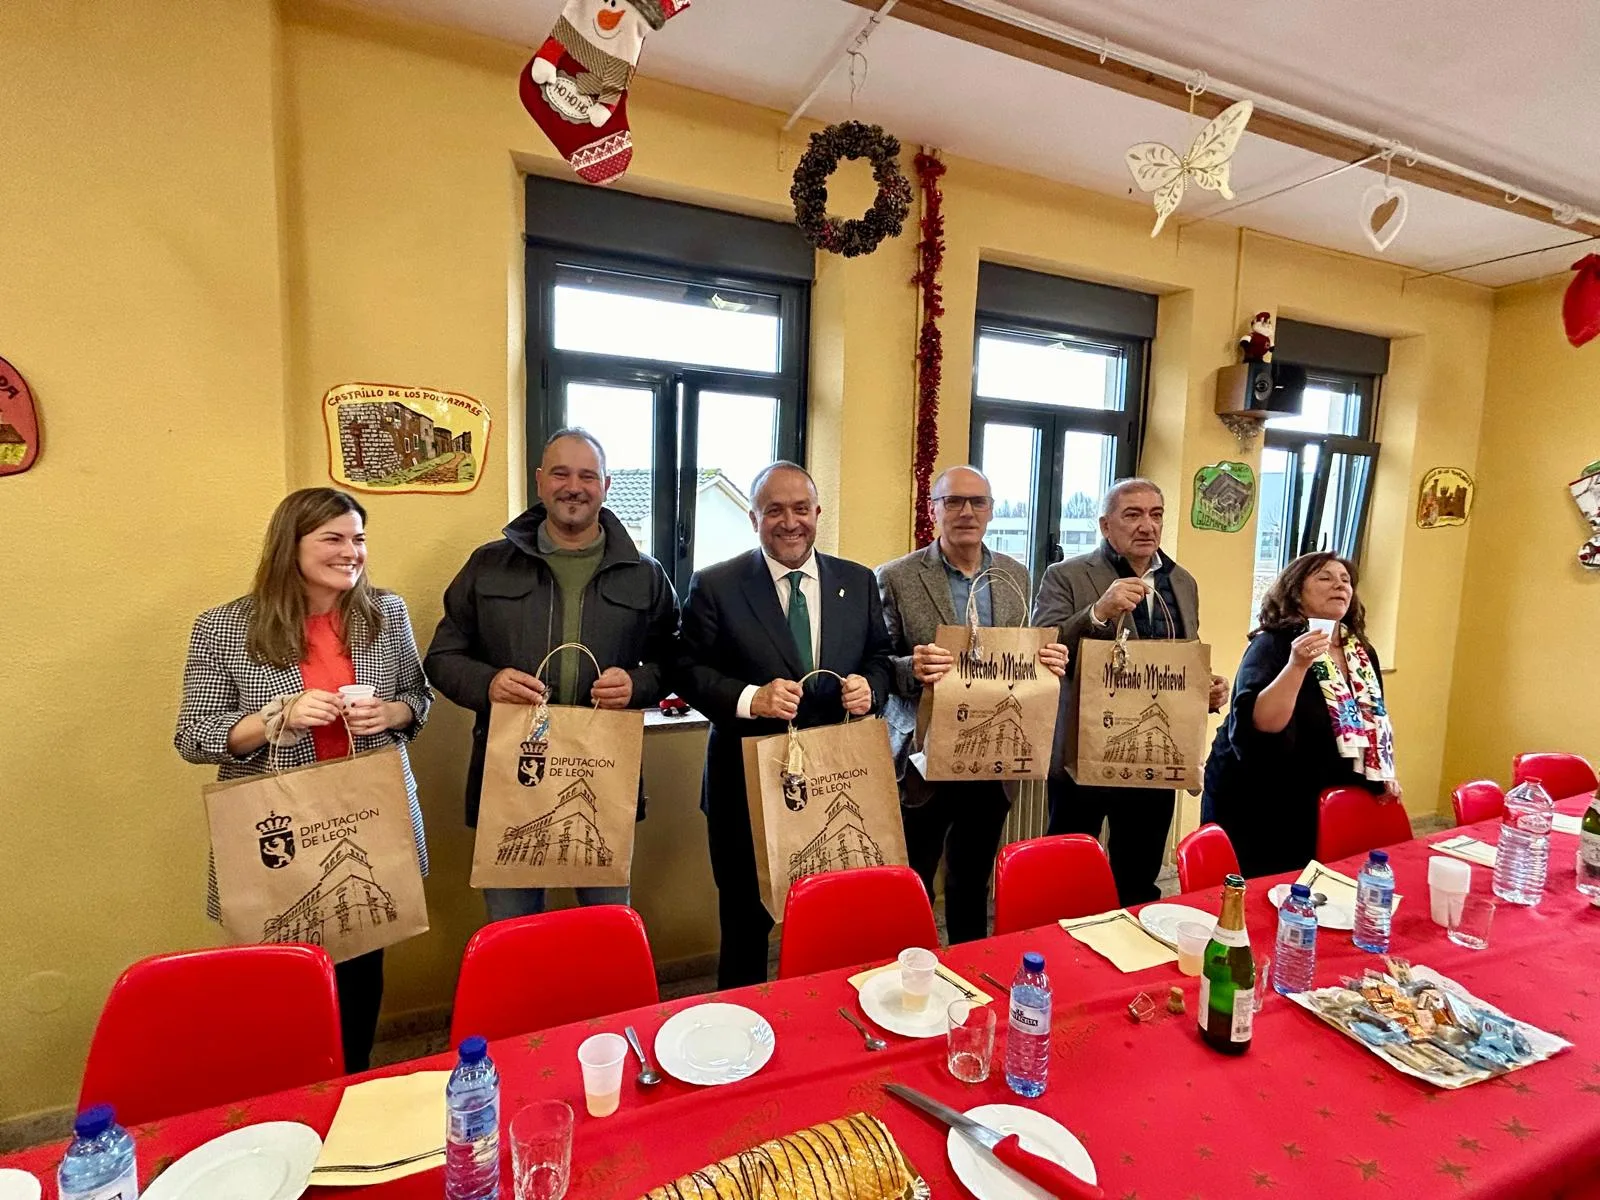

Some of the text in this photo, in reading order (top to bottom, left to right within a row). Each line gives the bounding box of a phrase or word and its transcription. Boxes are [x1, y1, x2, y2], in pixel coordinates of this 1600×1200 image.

[554, 83, 589, 114] HO HO HO
[389, 390, 400, 398] DE
[404, 390, 421, 399] LOS
[957, 651, 1037, 690] Mercado Medieval
[1102, 662, 1186, 700] Mercado Medieval
[549, 768, 594, 778] DE LEÓN
[551, 756, 615, 768] DIPUTACIÓN
[811, 781, 852, 797] DE LEÓN
[300, 808, 380, 837] DIPUTACIÓN
[302, 825, 358, 848] DE LEÓN
